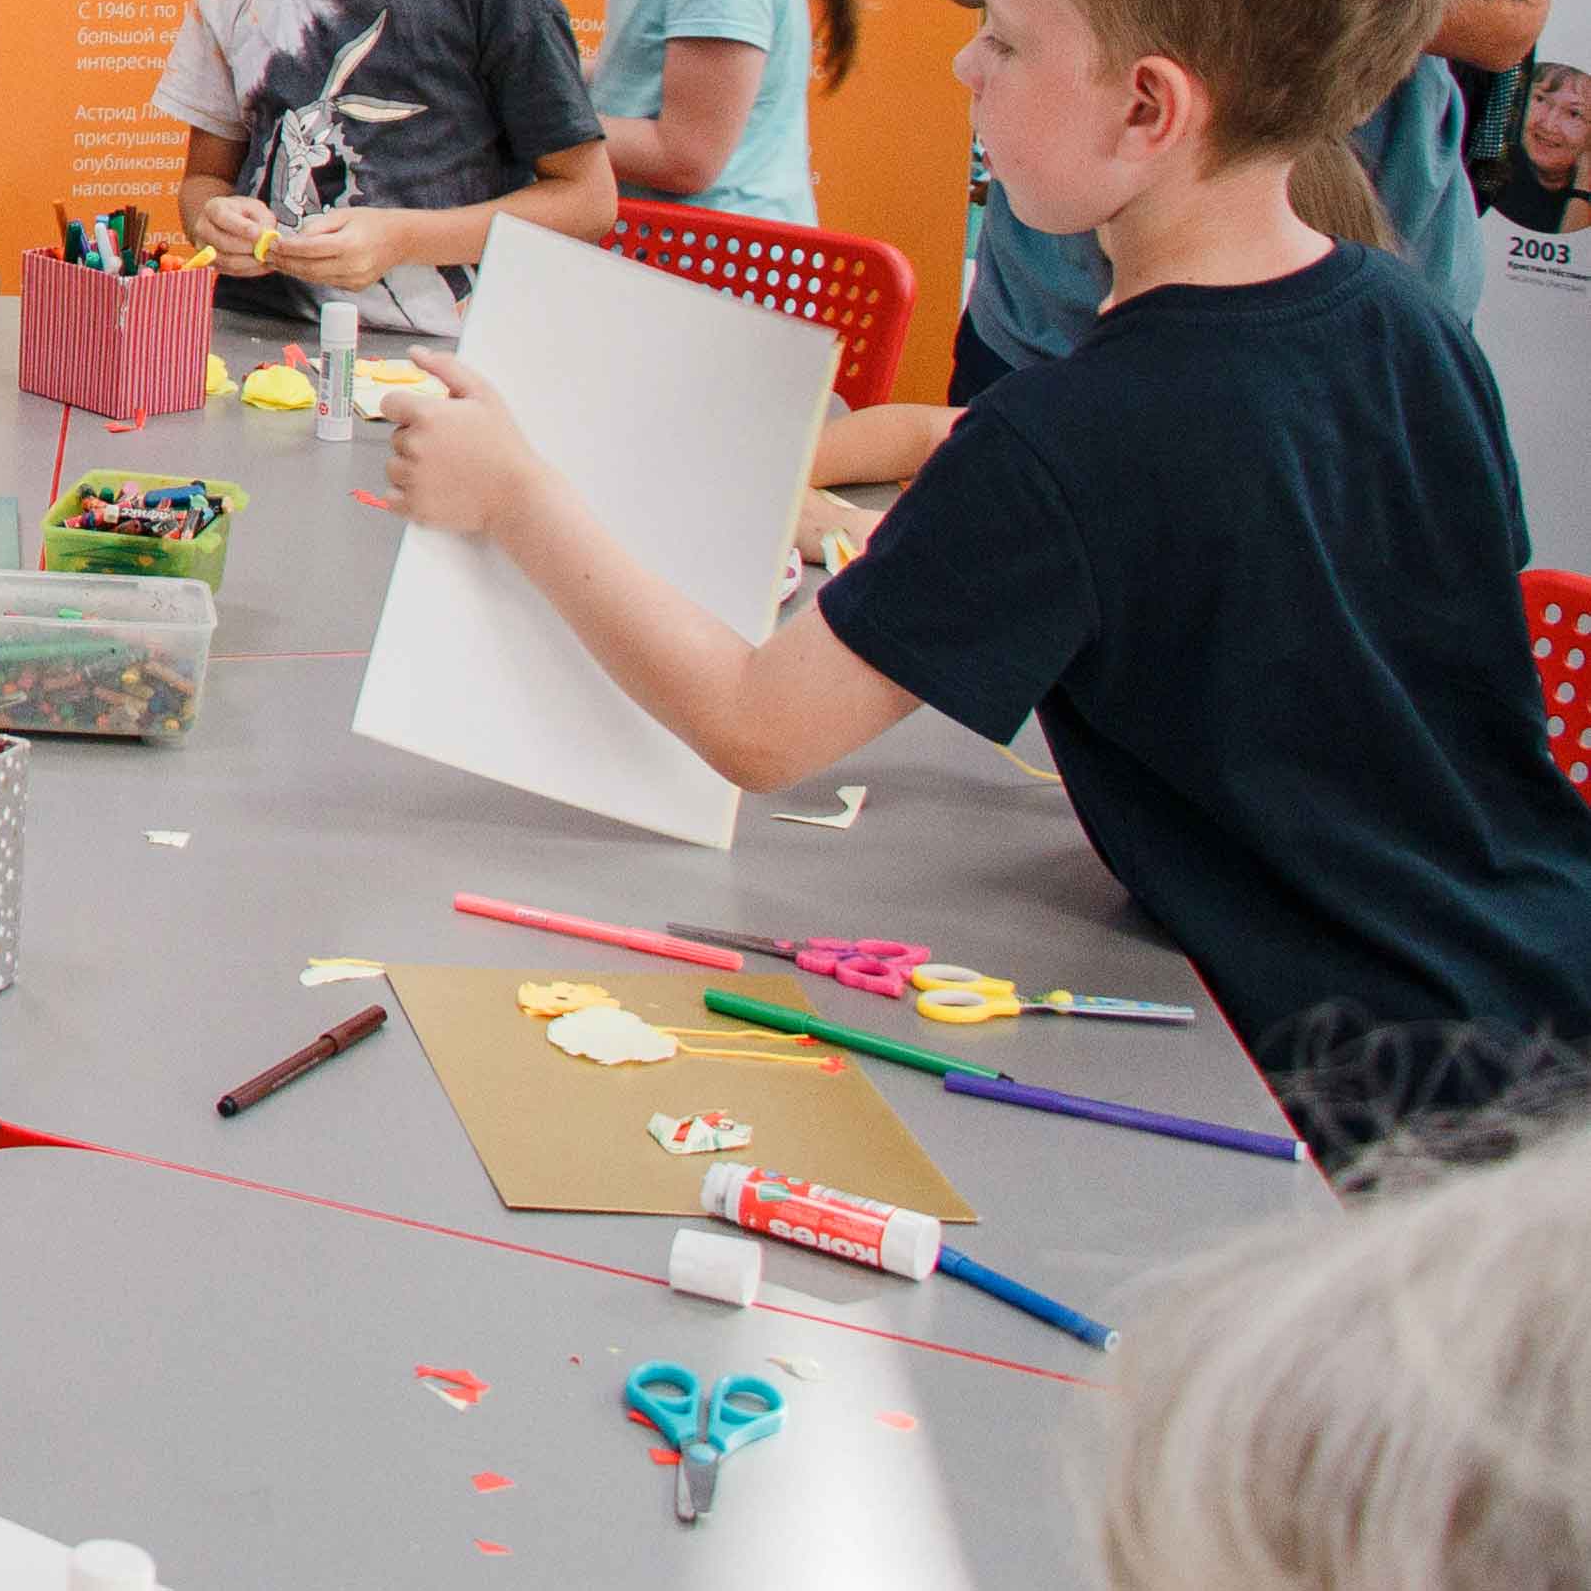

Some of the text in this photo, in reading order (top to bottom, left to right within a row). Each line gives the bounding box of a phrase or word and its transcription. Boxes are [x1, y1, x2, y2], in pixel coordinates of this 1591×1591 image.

[96, 2, 135, 20] 1946
[153, 5, 178, 20] по
[76, 27, 156, 47] большой
[74, 103, 136, 123] Астрид
[71, 180, 163, 198] налоговое
[1508, 234, 1572, 266] 2003
